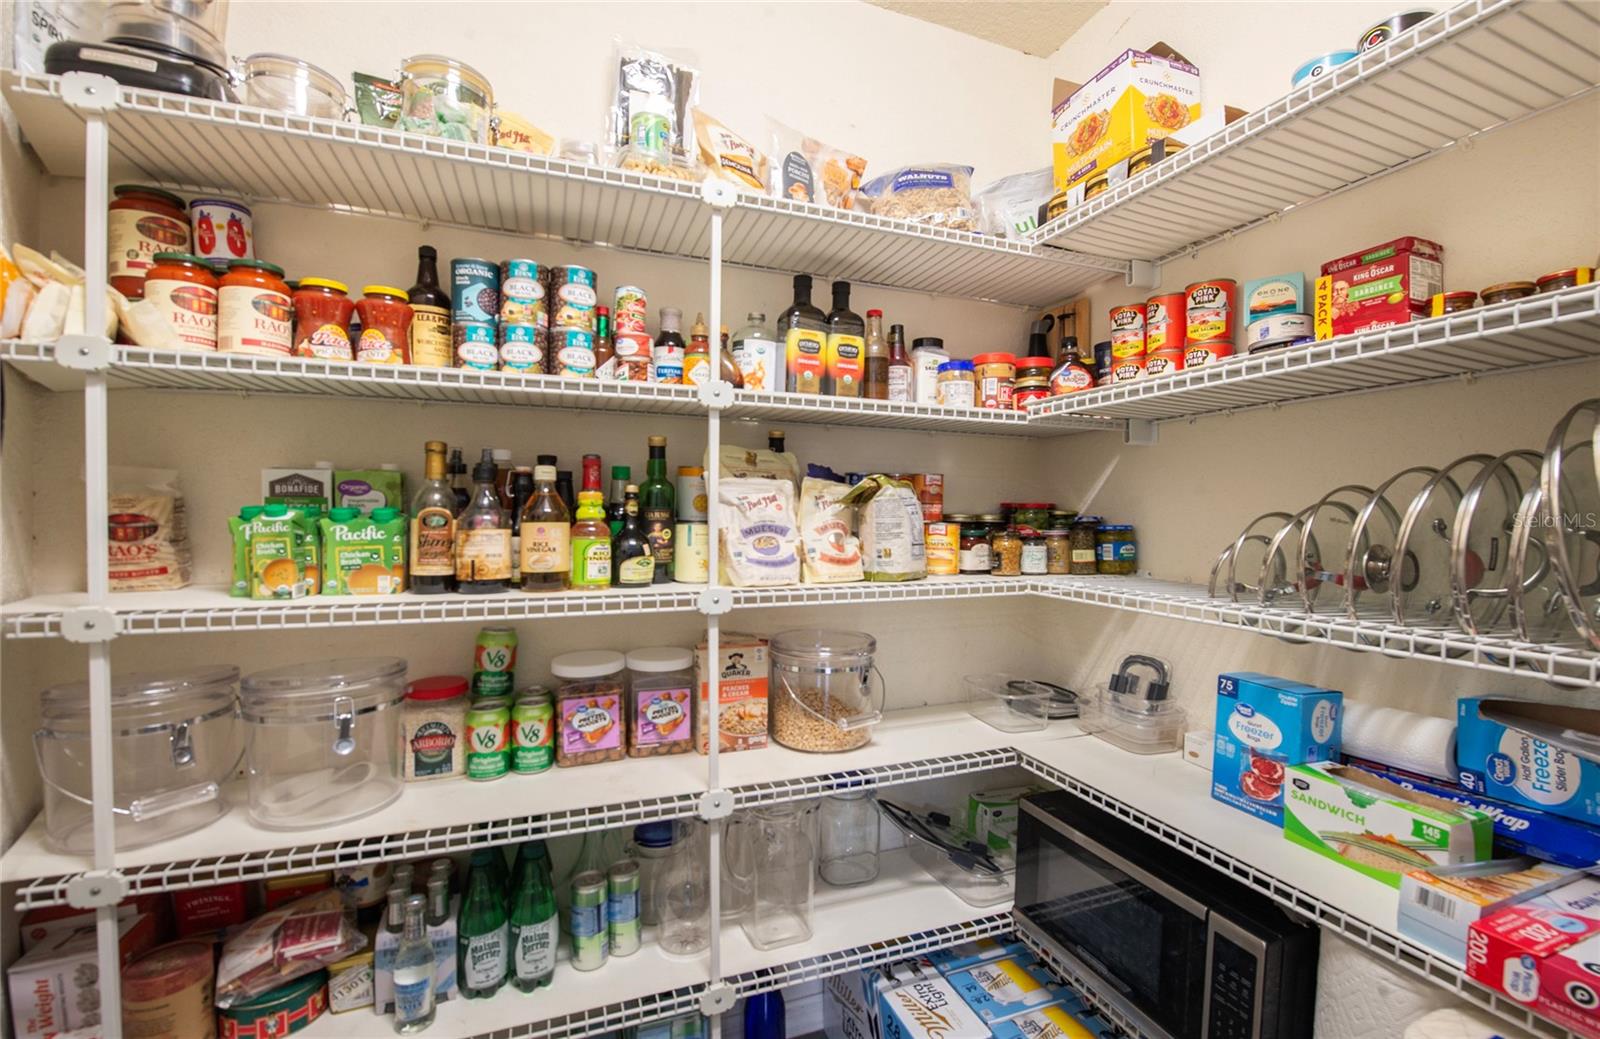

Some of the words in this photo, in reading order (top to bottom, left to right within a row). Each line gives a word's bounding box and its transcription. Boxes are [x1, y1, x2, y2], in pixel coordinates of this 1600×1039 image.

[1139, 77, 1194, 96] CRUNCHMASTER
[1059, 86, 1117, 132] CRUNCHMASTER
[897, 172, 948, 183] WALNUTS
[455, 267, 494, 279] ORGANIC
[1353, 271, 1370, 282] KING
[1370, 264, 1395, 278] OSCAR
[509, 283, 537, 294] BLACK
[1193, 287, 1220, 299] ROYAL
[1318, 280, 1328, 291] 4
[1354, 281, 1395, 298] SARDINES
[567, 289, 593, 300] BLACK
[1194, 294, 1215, 305] PINK
[417, 314, 430, 322] LEA
[1318, 295, 1328, 327] PACK
[466, 348, 494, 357] BLACK
[506, 347, 534, 357] BLACK
[566, 352, 592, 363] BLACK
[274, 484, 319, 495] BONAFIDE
[251, 520, 291, 535] Pacific
[330, 524, 387, 542] Pacific
[744, 524, 785, 537] MUESLI
[340, 551, 370, 560] Chicken
[340, 557, 362, 566] Broth
[487, 650, 506, 669] V8
[721, 670, 751, 679] QUAKER
[722, 684, 750, 692] PEACHES
[1220, 678, 1234, 691] 75
[727, 689, 750, 697] CREAM
[578, 712, 606, 724] PRETZEL
[651, 709, 679, 721] NUGGETS
[652, 705, 678, 716] PRETZEL
[577, 716, 607, 729] NUGGETS
[1236, 720, 1274, 740] Freezer
[476, 729, 497, 749] V8
[521, 724, 541, 743] V8
[1520, 736, 1531, 763] Gallon
[1522, 763, 1531, 781] Half
[1532, 738, 1553, 794] Freeze
[1459, 771, 1475, 790] 40
[1555, 767, 1568, 792] Slider
[1290, 790, 1366, 826] SANDWICH
[1476, 804, 1530, 832] Wrap
[1422, 825, 1441, 840] 145
[521, 931, 550, 945] Maison
[470, 940, 500, 954] Maison
[521, 940, 550, 961] Perrier
[1469, 928, 1489, 965] 200
[470, 949, 502, 971] Perrier
[913, 983, 939, 1011] Extra
[923, 980, 948, 1009] Light
[33, 978, 55, 1030] Weight
[894, 990, 950, 1039] Miller
